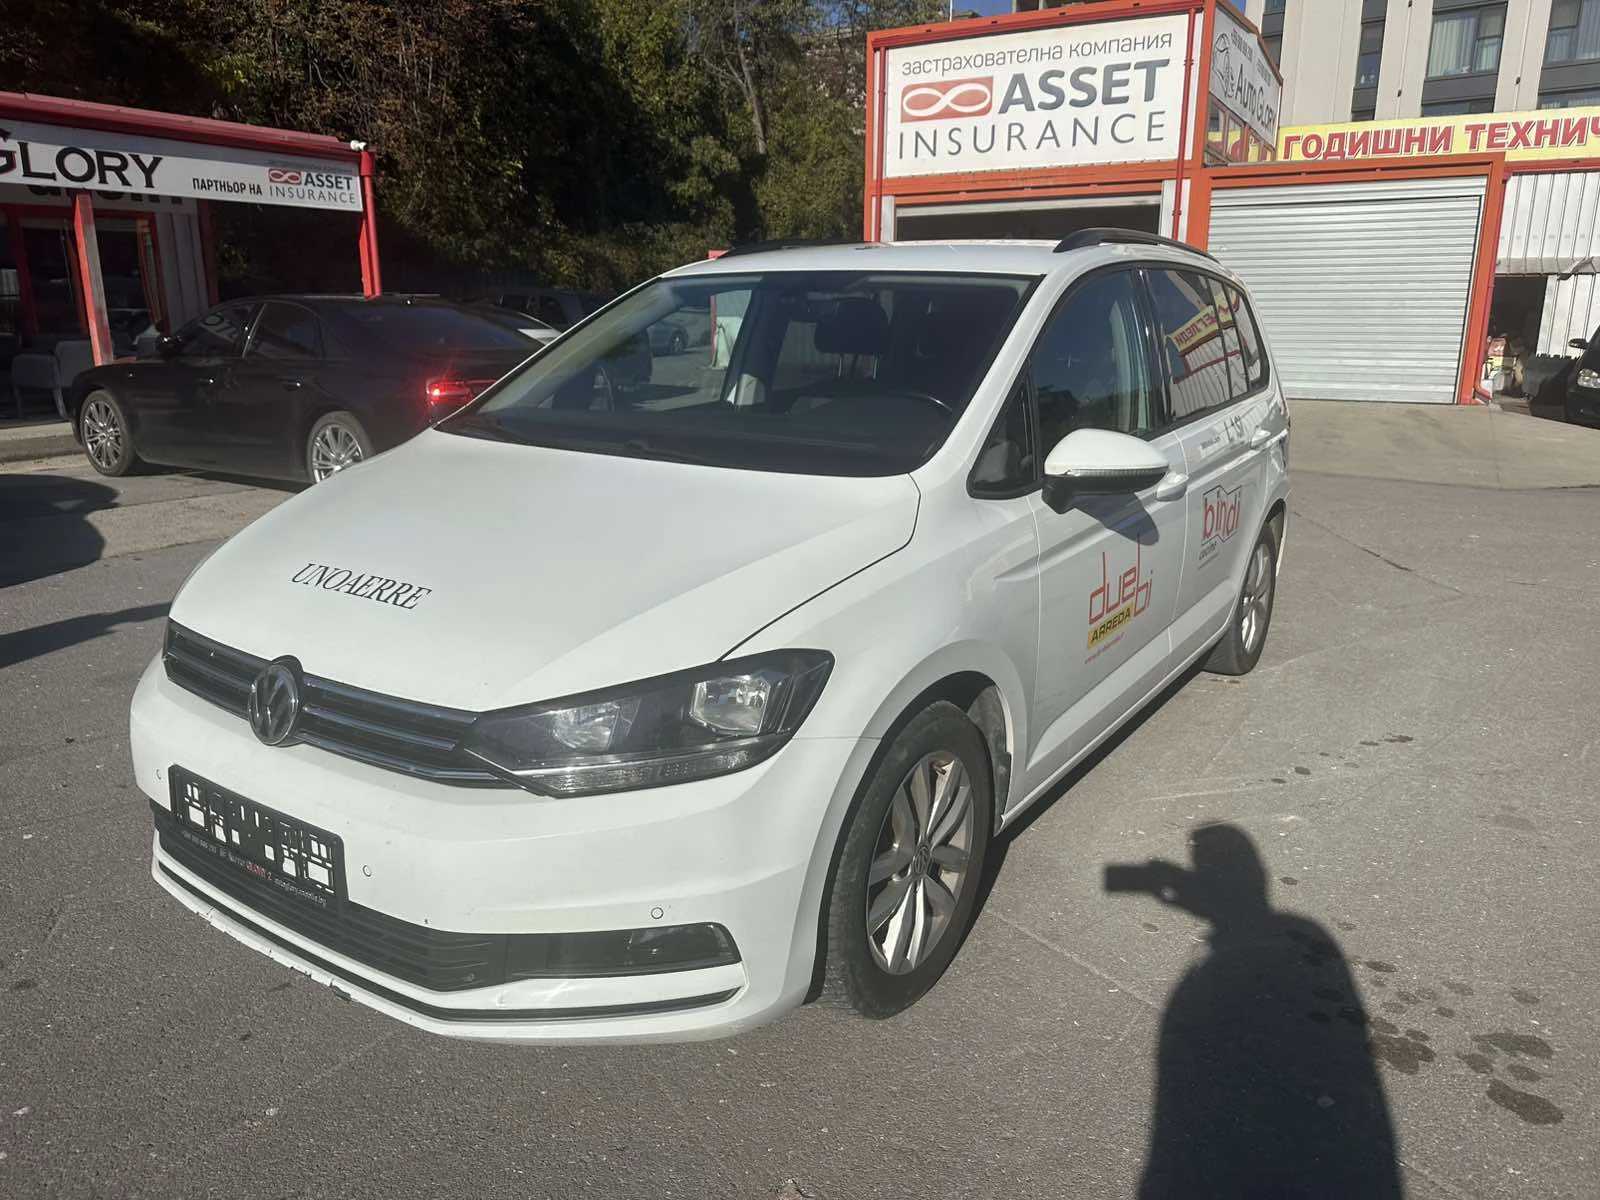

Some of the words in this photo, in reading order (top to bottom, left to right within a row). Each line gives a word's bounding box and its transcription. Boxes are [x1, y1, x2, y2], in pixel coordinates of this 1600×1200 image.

[902, 47, 1063, 76] застрахователна
[1069, 32, 1172, 59] компания
[998, 58, 1170, 115] ASSET
[899, 111, 1167, 160] INSURANCE
[1283, 126, 1455, 161] ГОДИШНИ
[192, 178, 247, 194] ПАРТНЬОР
[249, 183, 263, 196] НА
[269, 185, 356, 204] INSURANCE
[304, 172, 353, 190] ASSET
[1203, 490, 1241, 540] bindi
[291, 562, 433, 610] UNOAERRE
[1090, 607, 1132, 644] ARREDA
